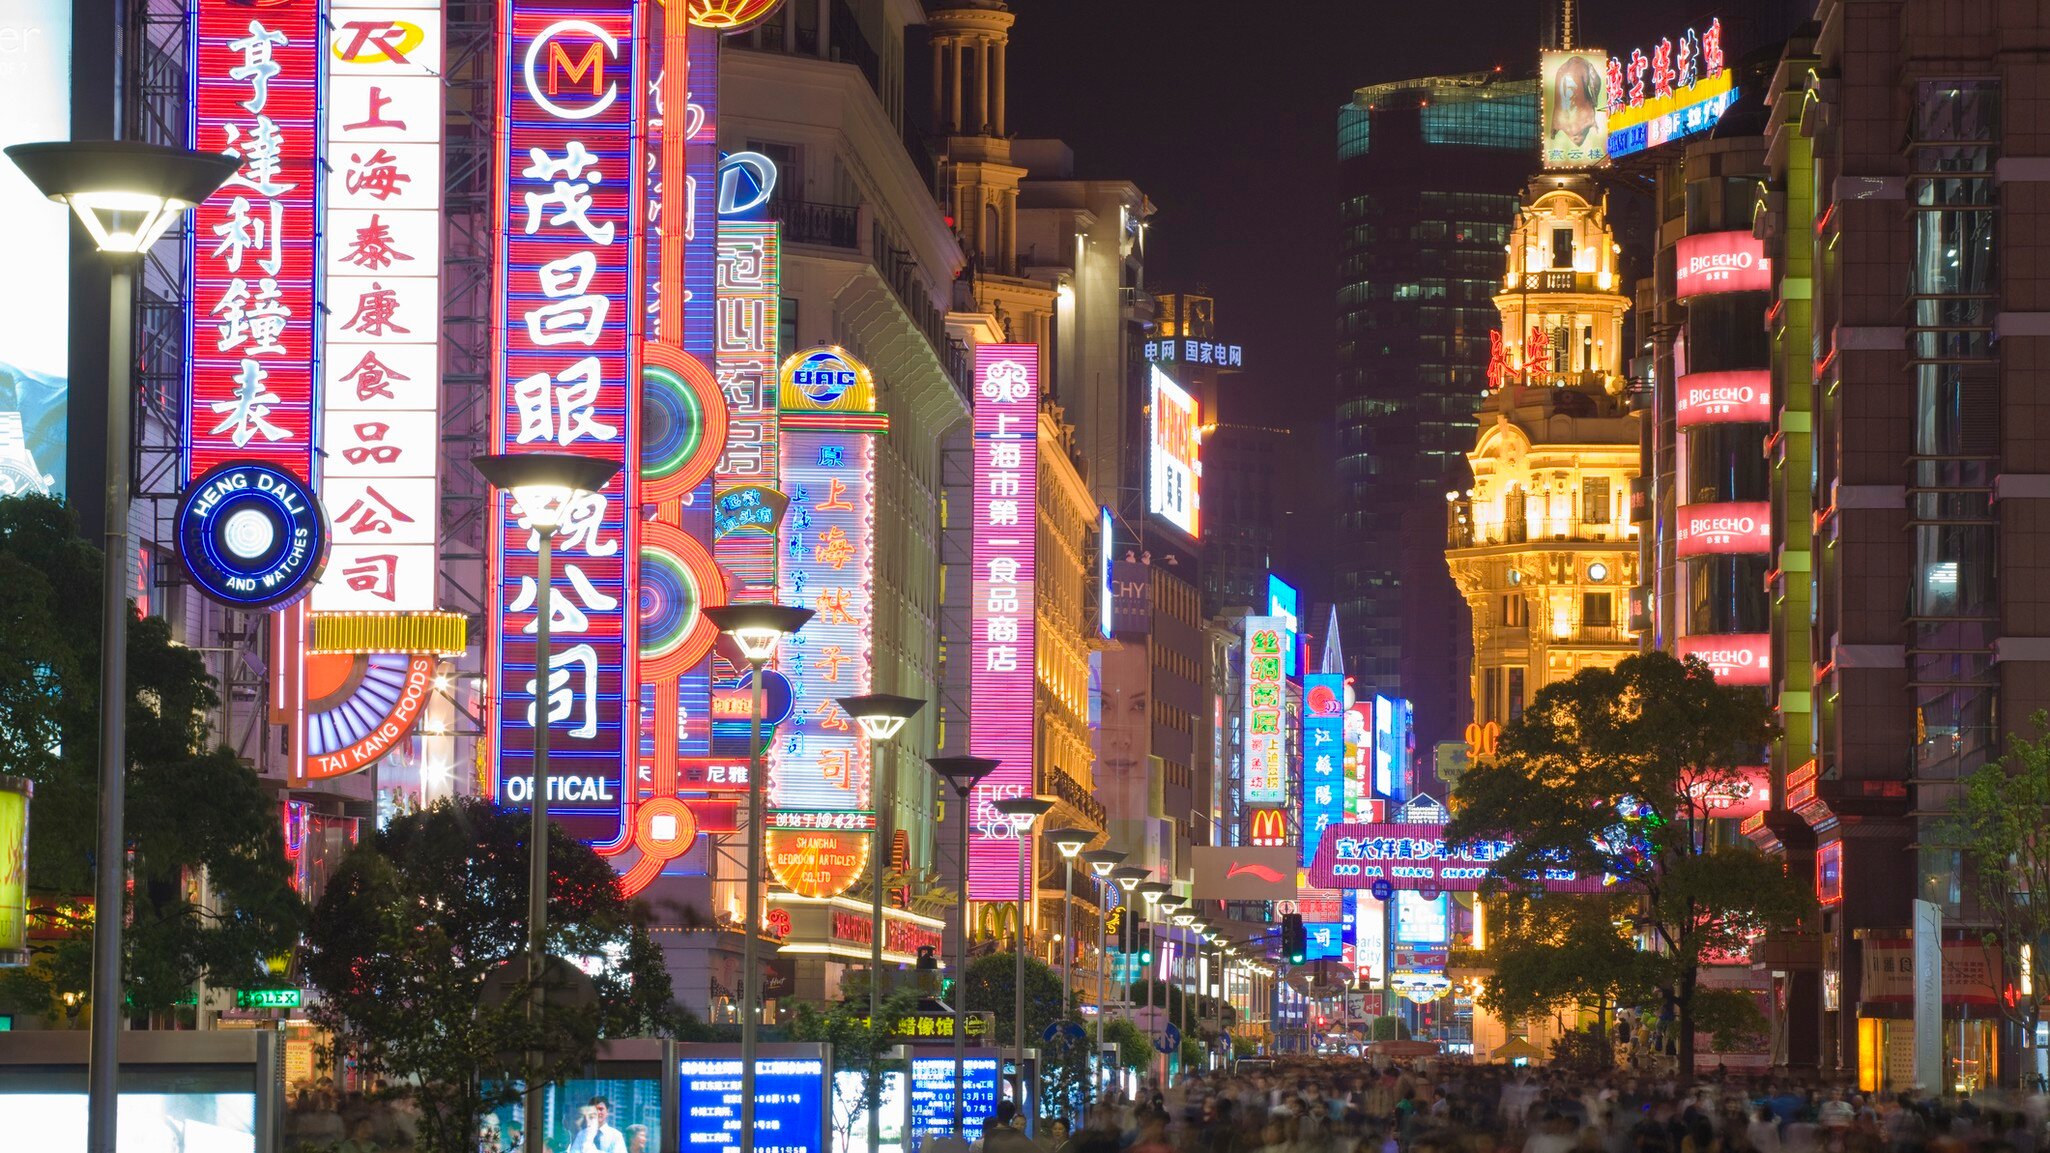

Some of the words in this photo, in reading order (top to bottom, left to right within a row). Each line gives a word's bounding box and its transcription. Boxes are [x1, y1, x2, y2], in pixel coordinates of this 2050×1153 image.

[1691, 256, 1710, 273] BIG
[1712, 252, 1752, 268] ECHO
[334, 86, 415, 602] 上海泰康食品公司
[1185, 340, 1241, 367] 国家电网
[793, 370, 856, 387] BAC
[1690, 389, 1710, 405] BIG
[1713, 386, 1753, 402] ECHO
[193, 473, 247, 517] HENG
[257, 473, 305, 515] DALI
[1691, 519, 1710, 535] BIG
[1713, 517, 1754, 533] ECHO
[986, 412, 1022, 672] 上海市第一食品商店
[226, 576, 256, 591] AND
[262, 528, 308, 588] WATCHES
[1712, 649, 1752, 665] ECHO
[318, 757, 347, 773] TAI
[352, 723, 399, 763] KANG
[396, 659, 428, 722] FOODS
[796, 837, 838, 849] SHANGHAI
[818, 854, 857, 867] ARTICLES
[1391, 866, 1434, 878] XIANG
